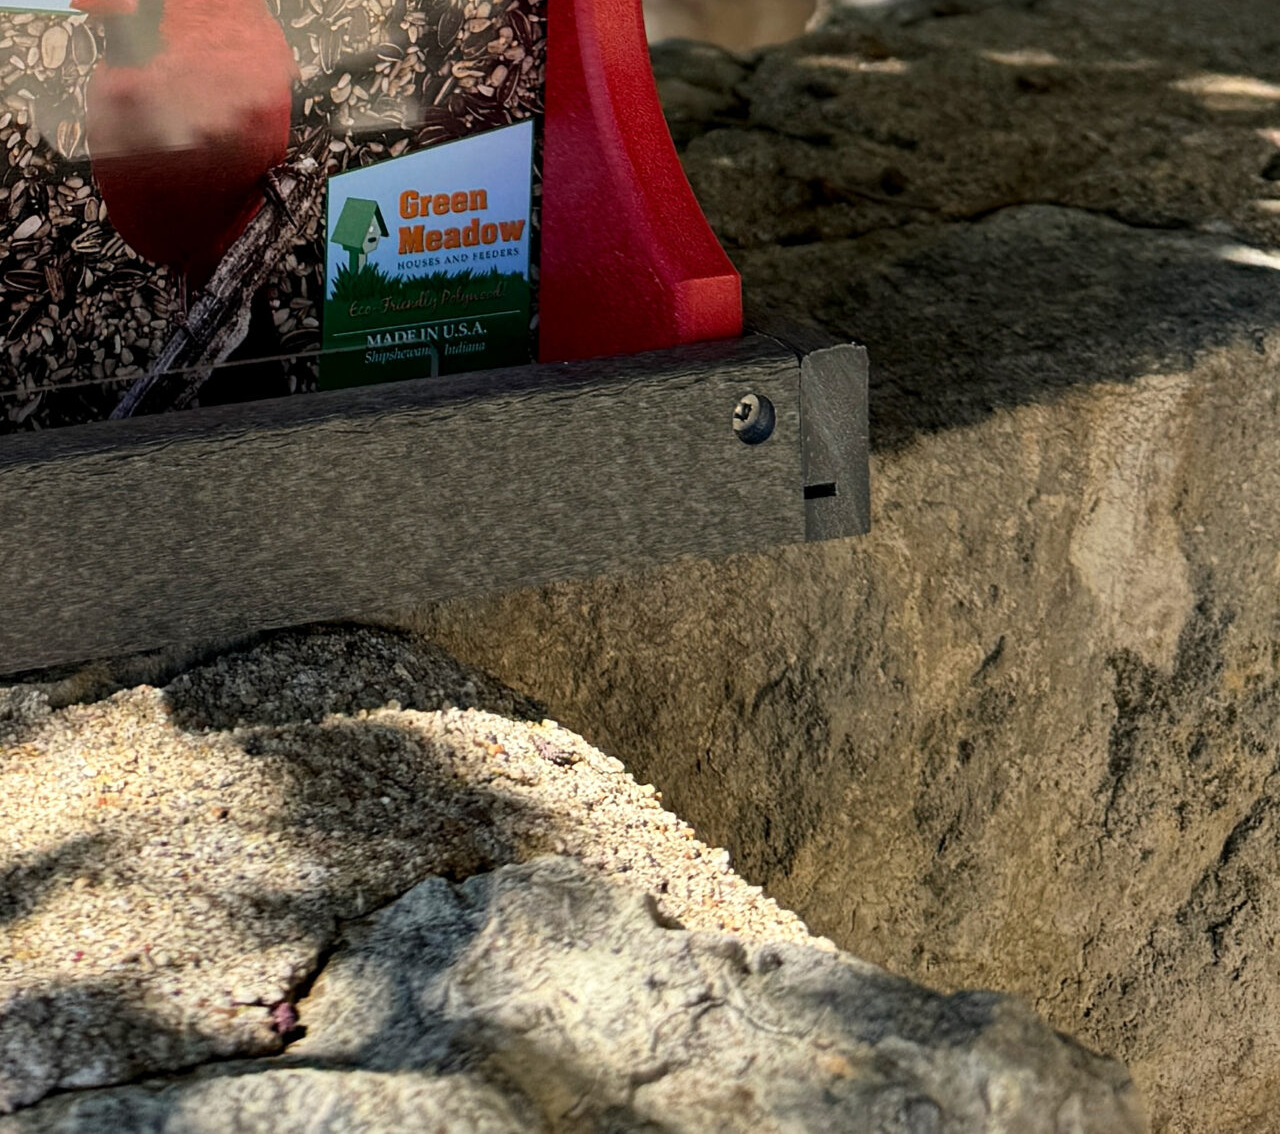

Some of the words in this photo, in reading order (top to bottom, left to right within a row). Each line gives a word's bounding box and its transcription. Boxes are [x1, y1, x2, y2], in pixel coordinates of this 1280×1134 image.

[399, 189, 488, 220] Green
[398, 219, 526, 255] Meadow
[397, 258, 440, 271] HOUSES
[445, 254, 469, 265] AND
[473, 247, 519, 261] FEEDERS
[366, 331, 415, 348] MADE
[421, 326, 438, 341] IN
[444, 321, 488, 338] U.S.A.
[444, 341, 486, 356] Indiana
